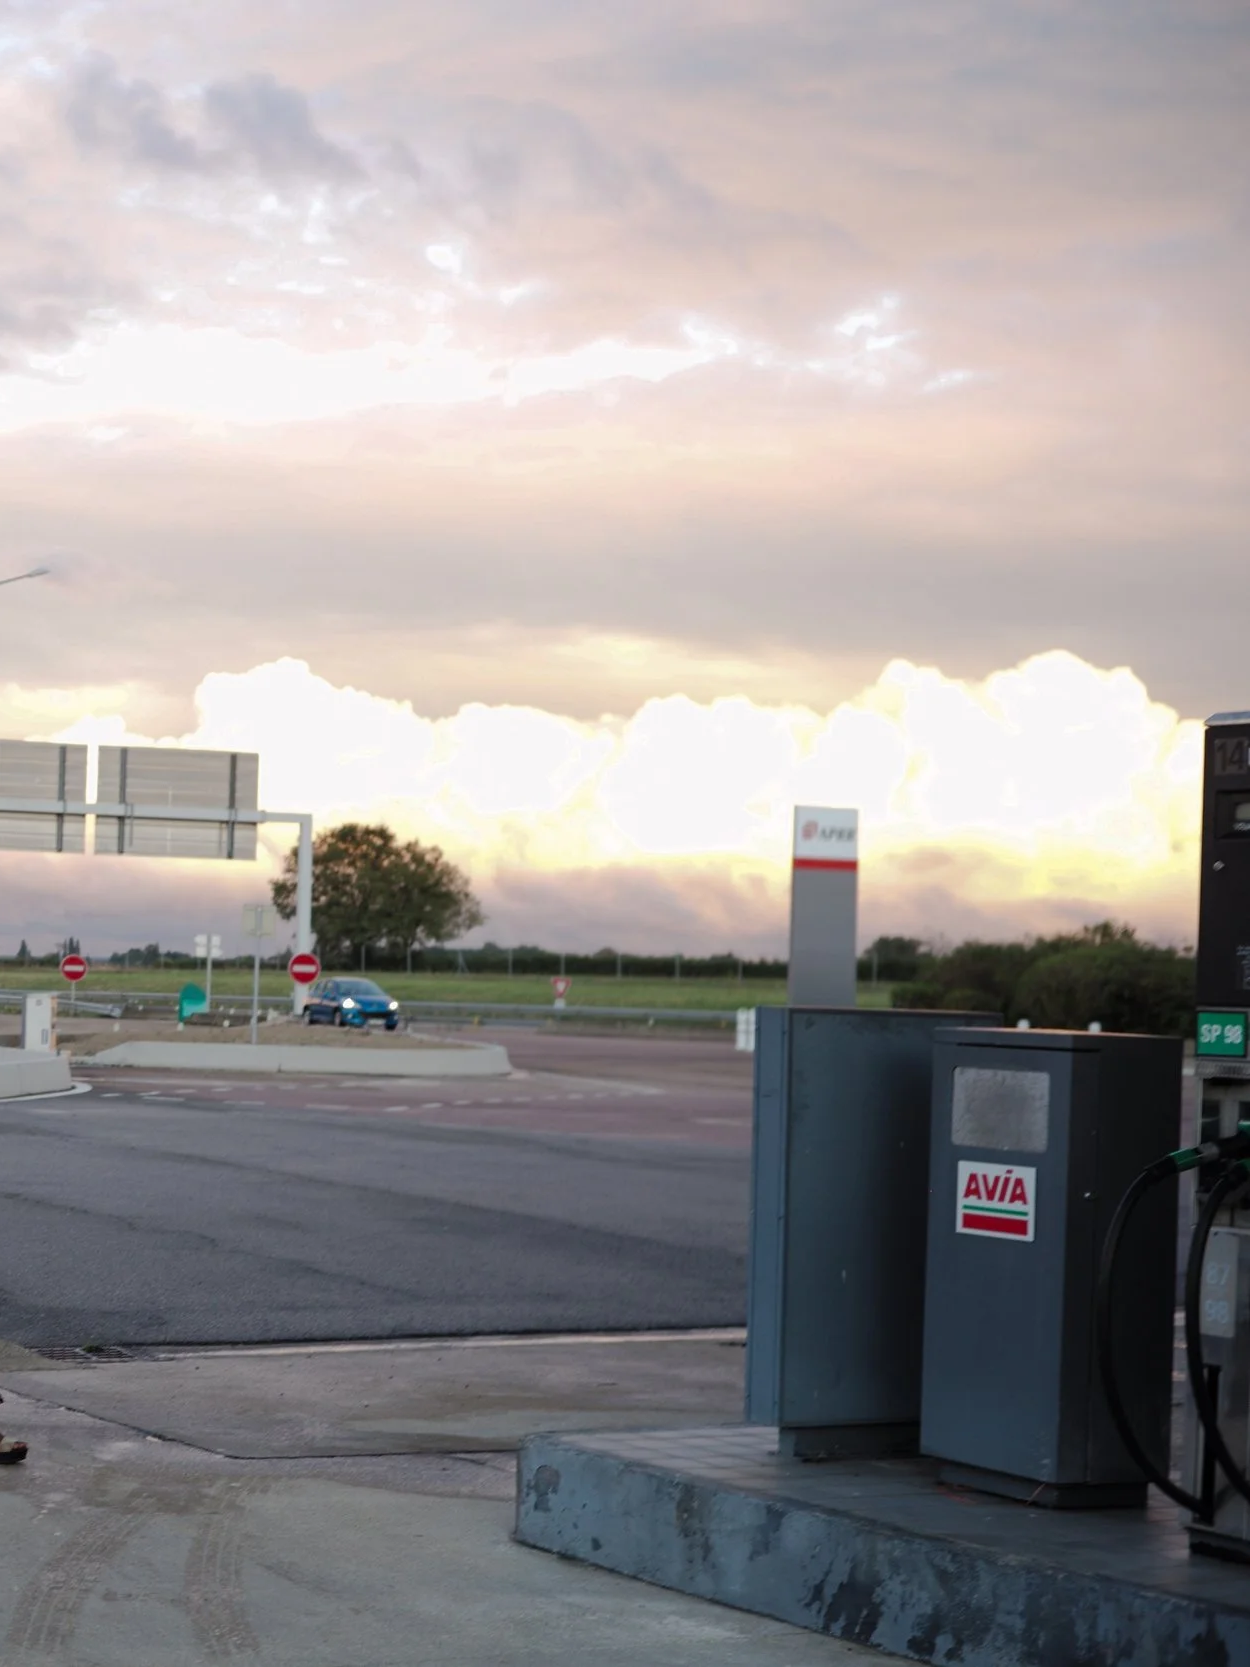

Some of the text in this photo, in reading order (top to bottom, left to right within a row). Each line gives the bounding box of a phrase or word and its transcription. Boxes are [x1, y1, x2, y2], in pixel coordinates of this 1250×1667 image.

[1217, 740, 1246, 772] 14
[1200, 1023, 1243, 1045] SP 98
